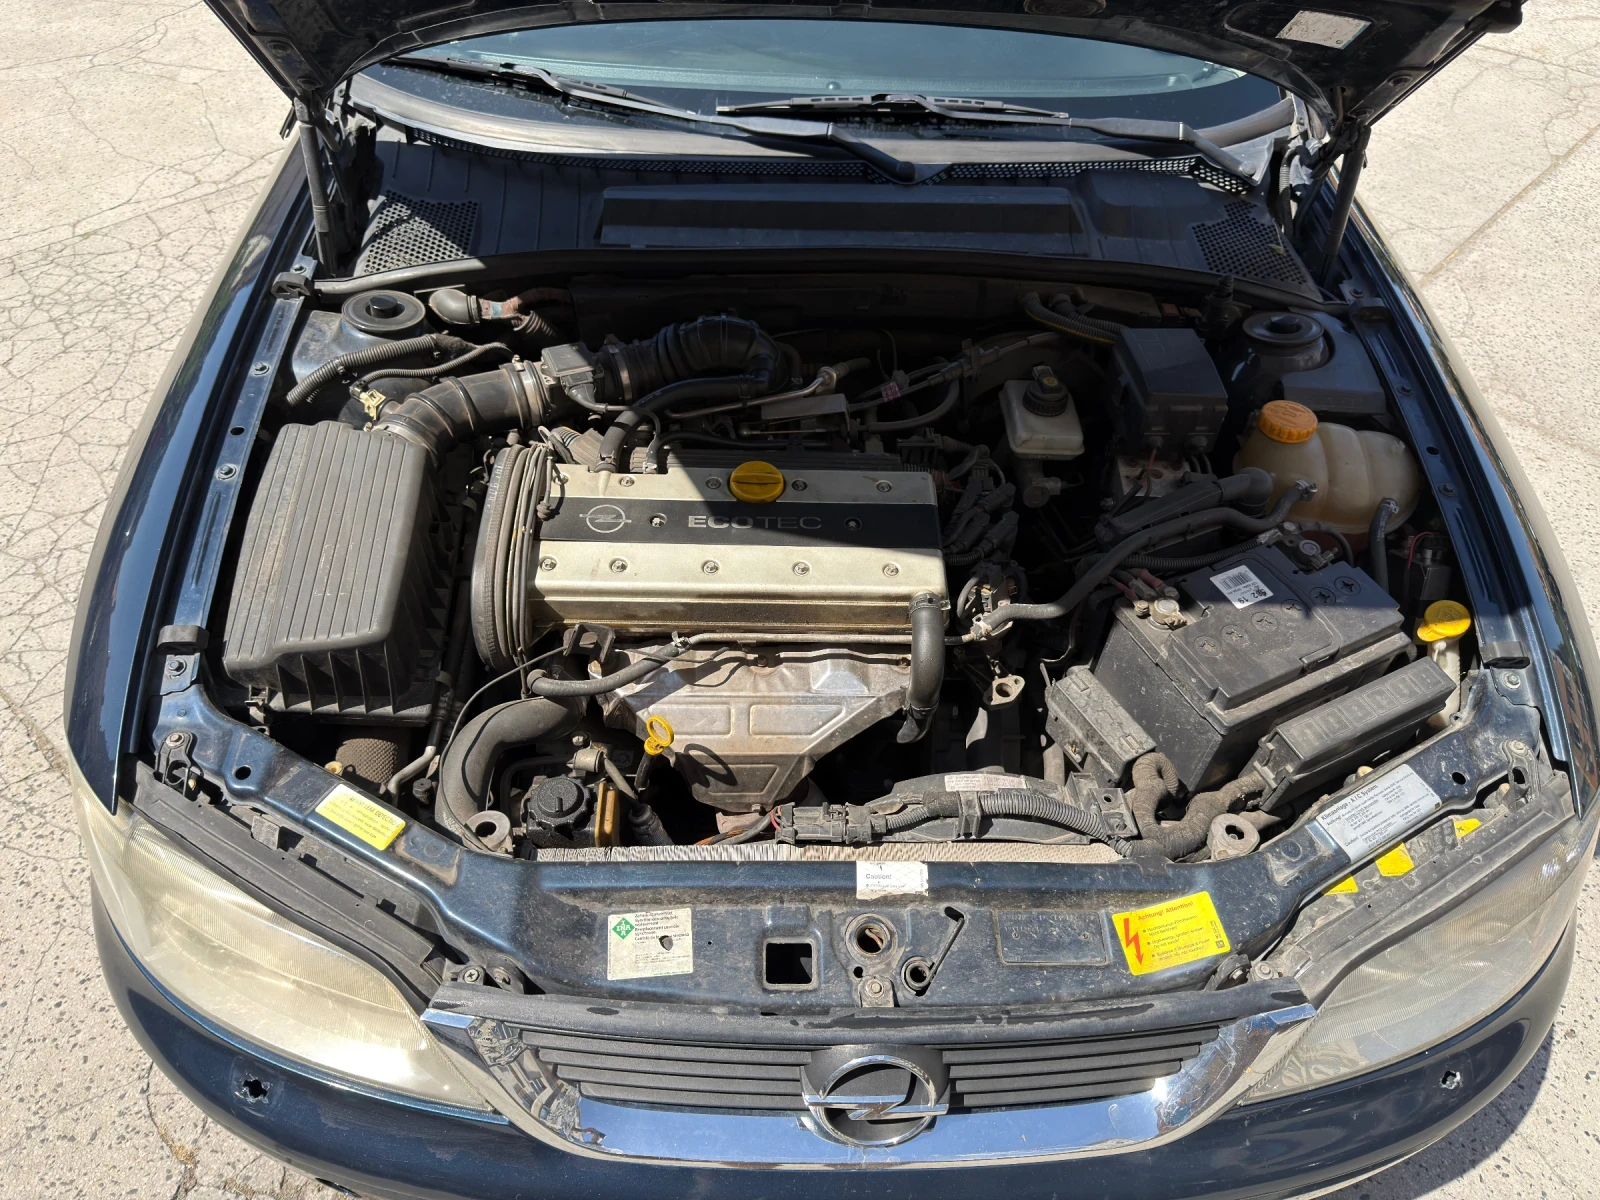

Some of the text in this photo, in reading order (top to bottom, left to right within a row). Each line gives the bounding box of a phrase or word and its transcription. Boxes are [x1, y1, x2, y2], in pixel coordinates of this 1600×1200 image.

[688, 515, 822, 529] ECOTEC
[1320, 801, 1348, 821] Klimaanlage
[1361, 785, 1379, 799] System
[1137, 901, 1194, 921] Achtung! Attention!
